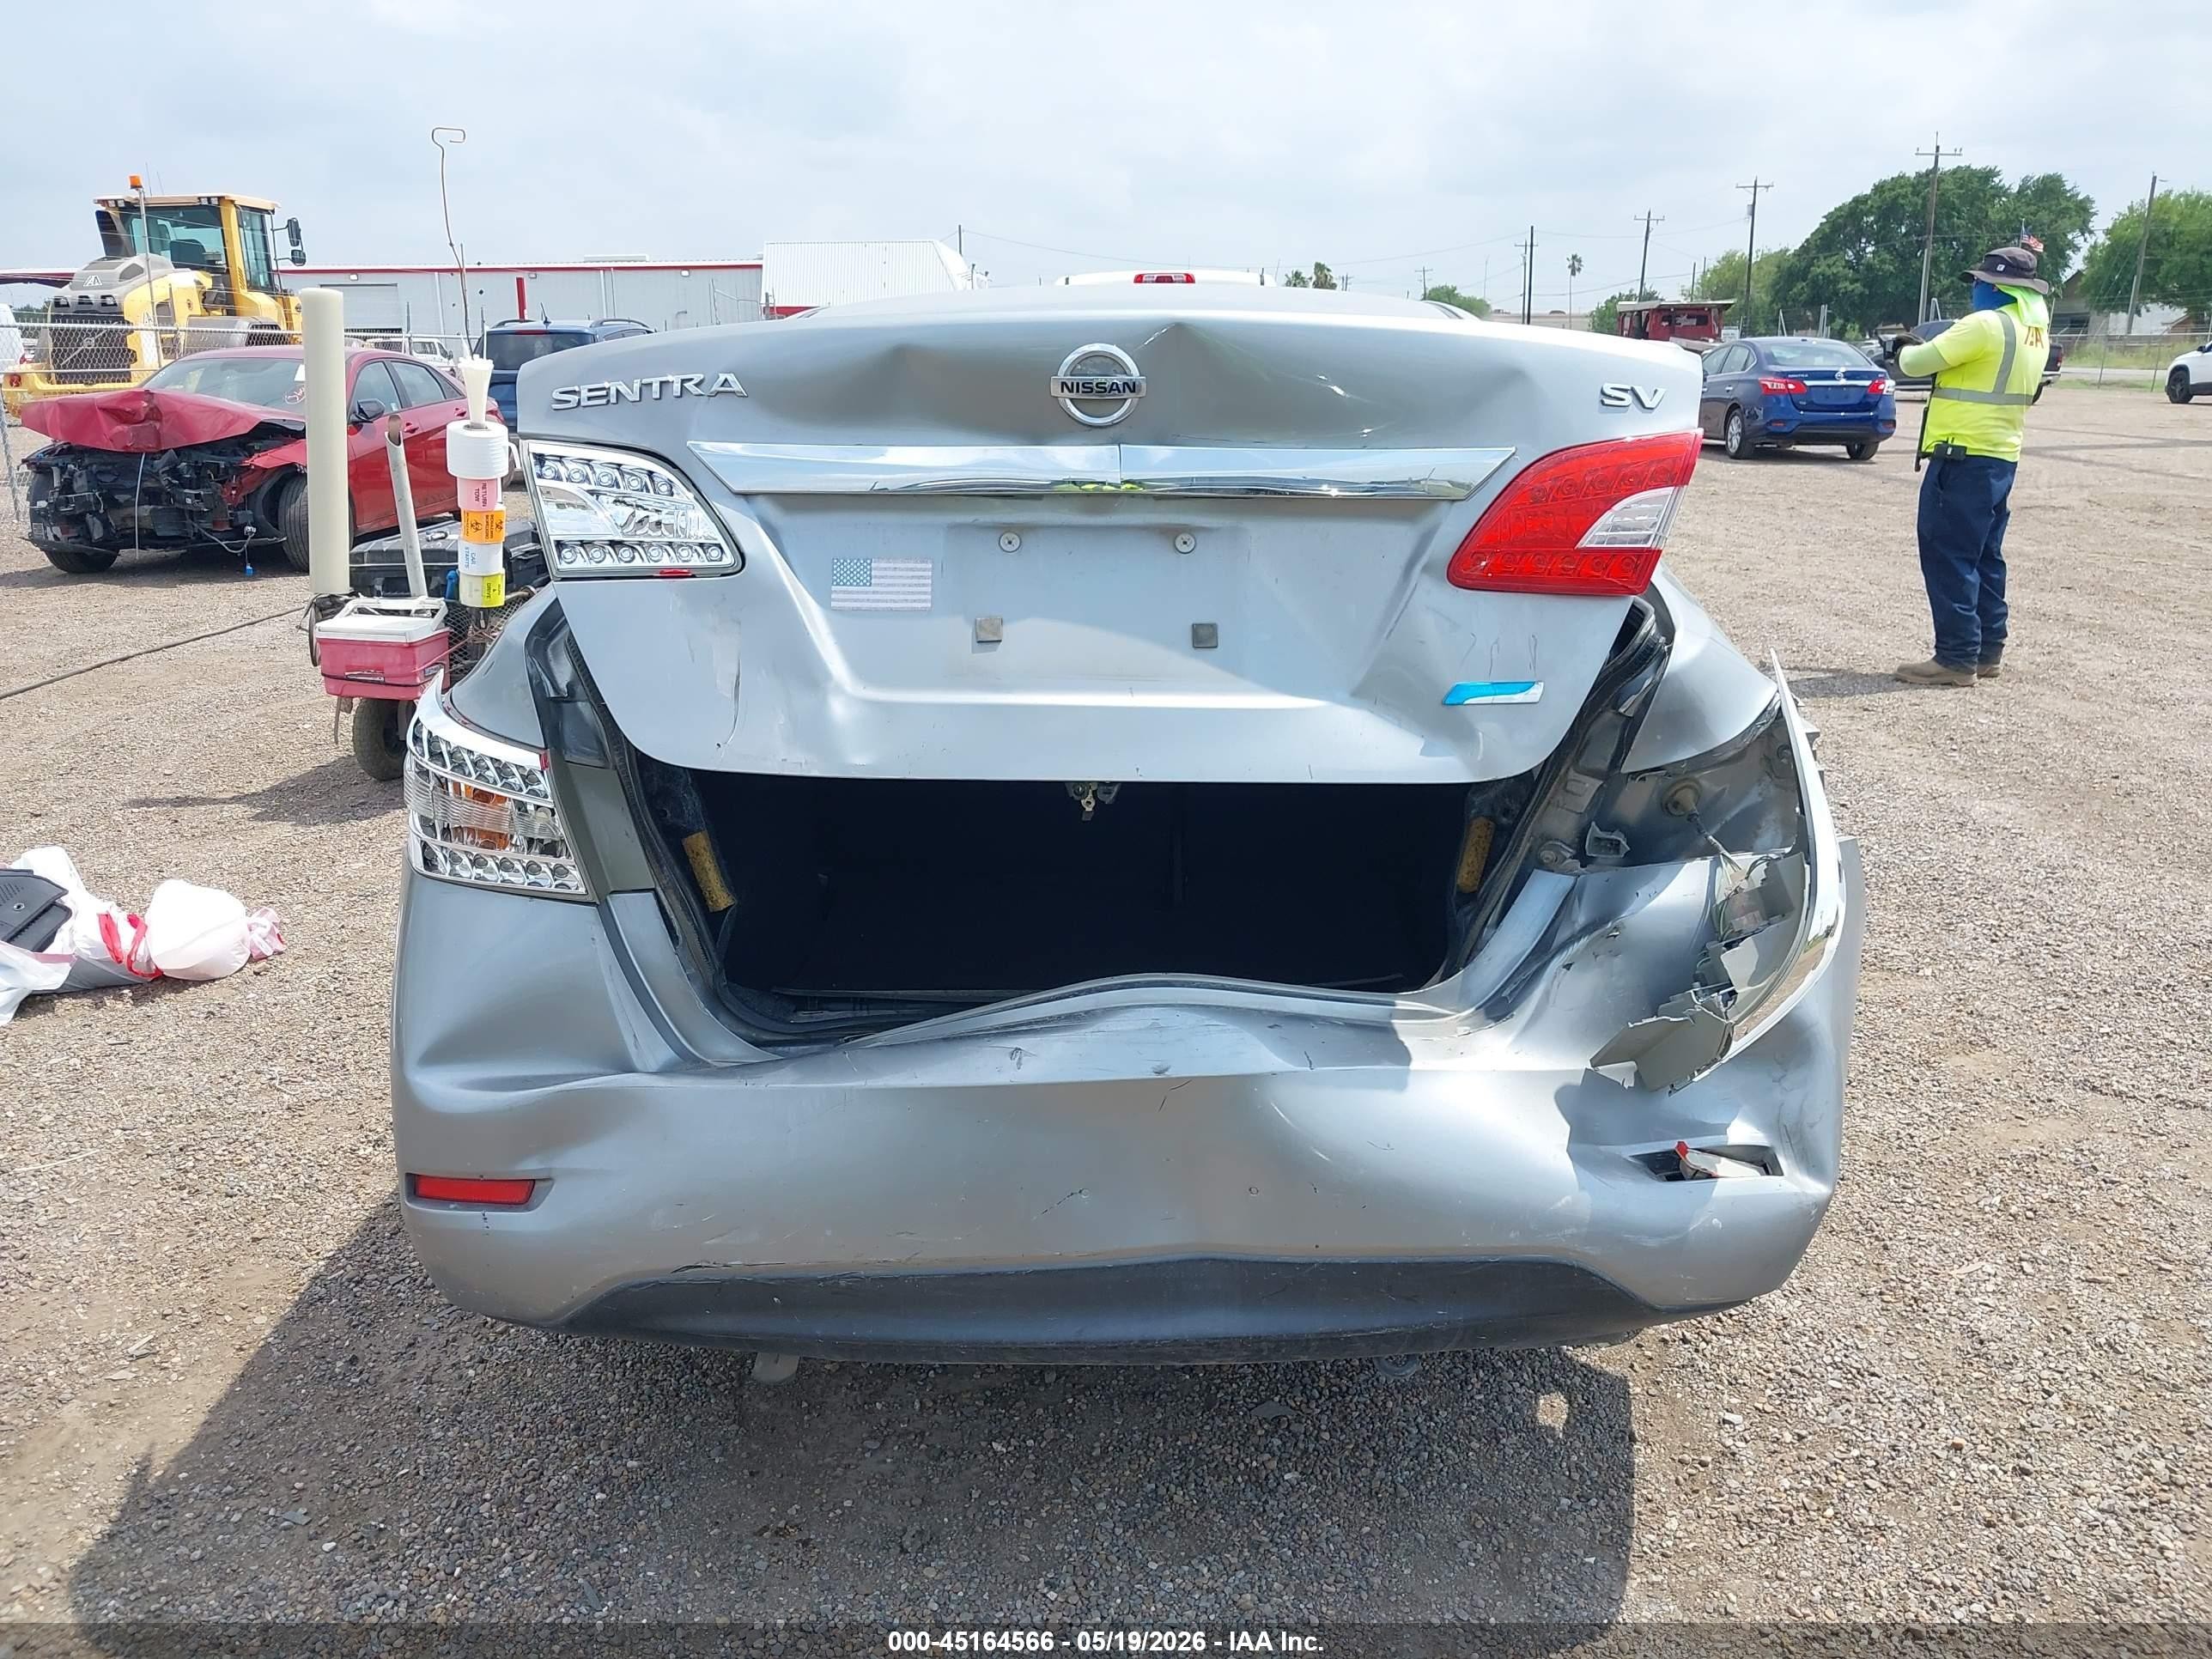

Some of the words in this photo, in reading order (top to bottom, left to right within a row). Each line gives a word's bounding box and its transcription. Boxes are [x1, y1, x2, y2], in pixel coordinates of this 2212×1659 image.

[550, 372, 749, 410] SENTRA
[1058, 378, 1139, 395] NISSAN
[1600, 383, 1666, 411] SV
